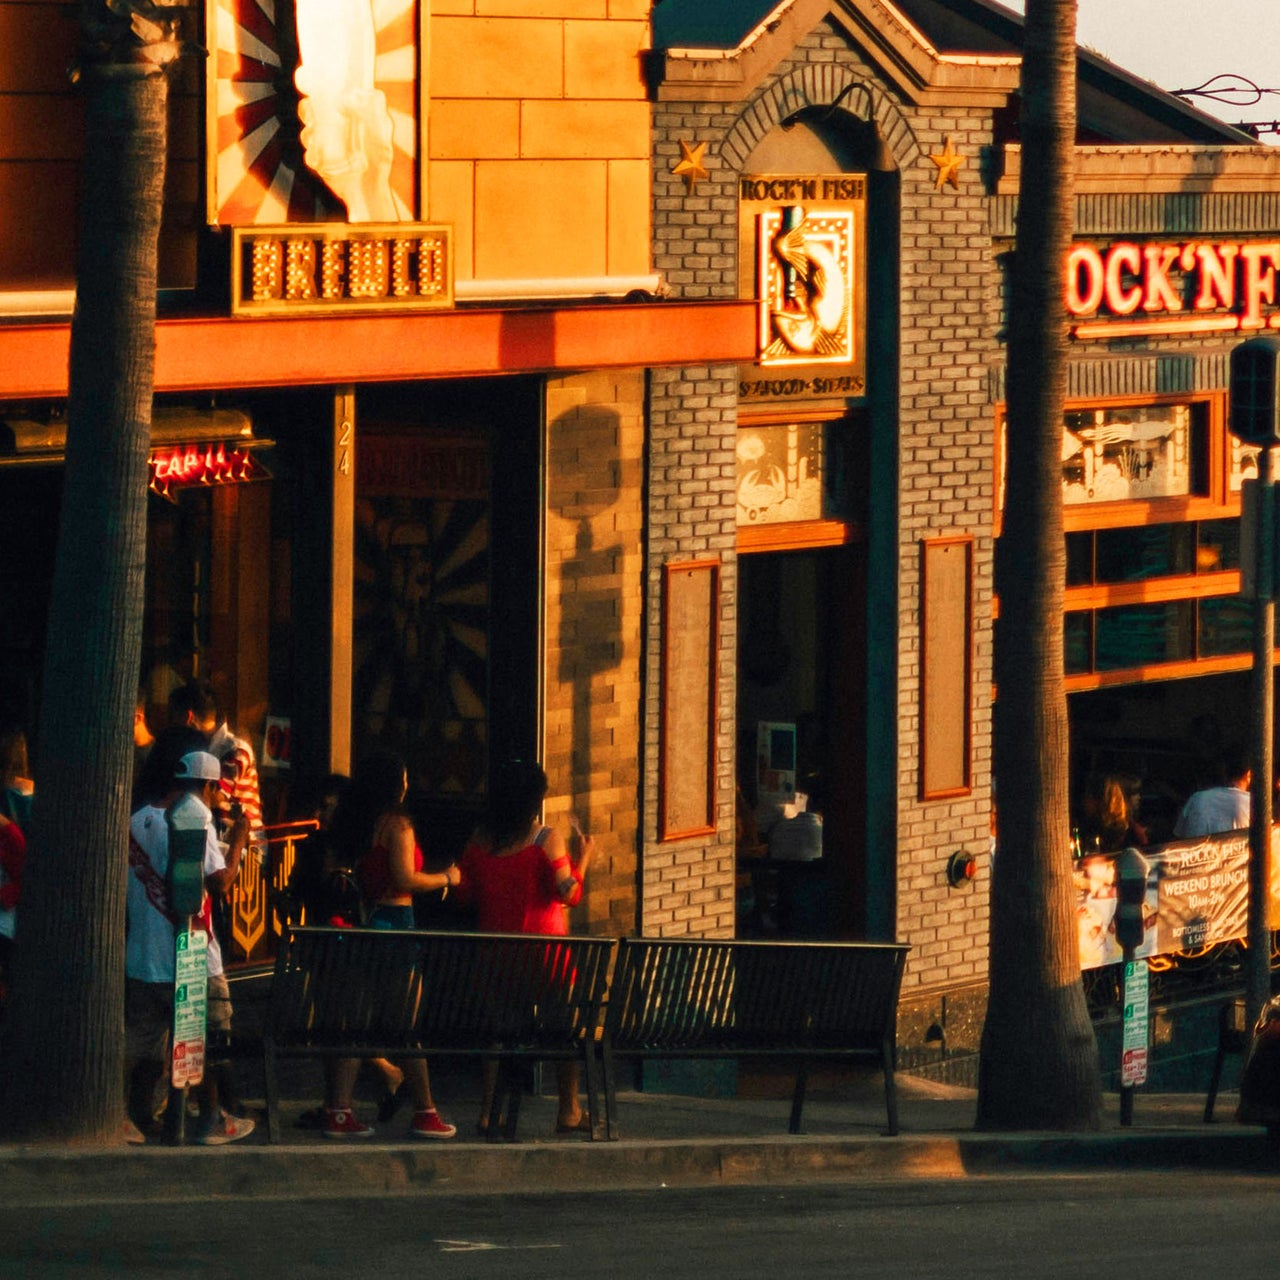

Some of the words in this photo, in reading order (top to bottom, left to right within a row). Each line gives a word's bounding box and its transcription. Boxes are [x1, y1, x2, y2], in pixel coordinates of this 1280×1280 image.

[741, 179, 817, 201] ROCK'N
[822, 179, 864, 200] FISH
[253, 239, 446, 300] BREWCO
[1063, 241, 1238, 316] OCK'N
[1164, 876, 1208, 896] WEEKEND
[1210, 869, 1247, 889] BRUNCH
